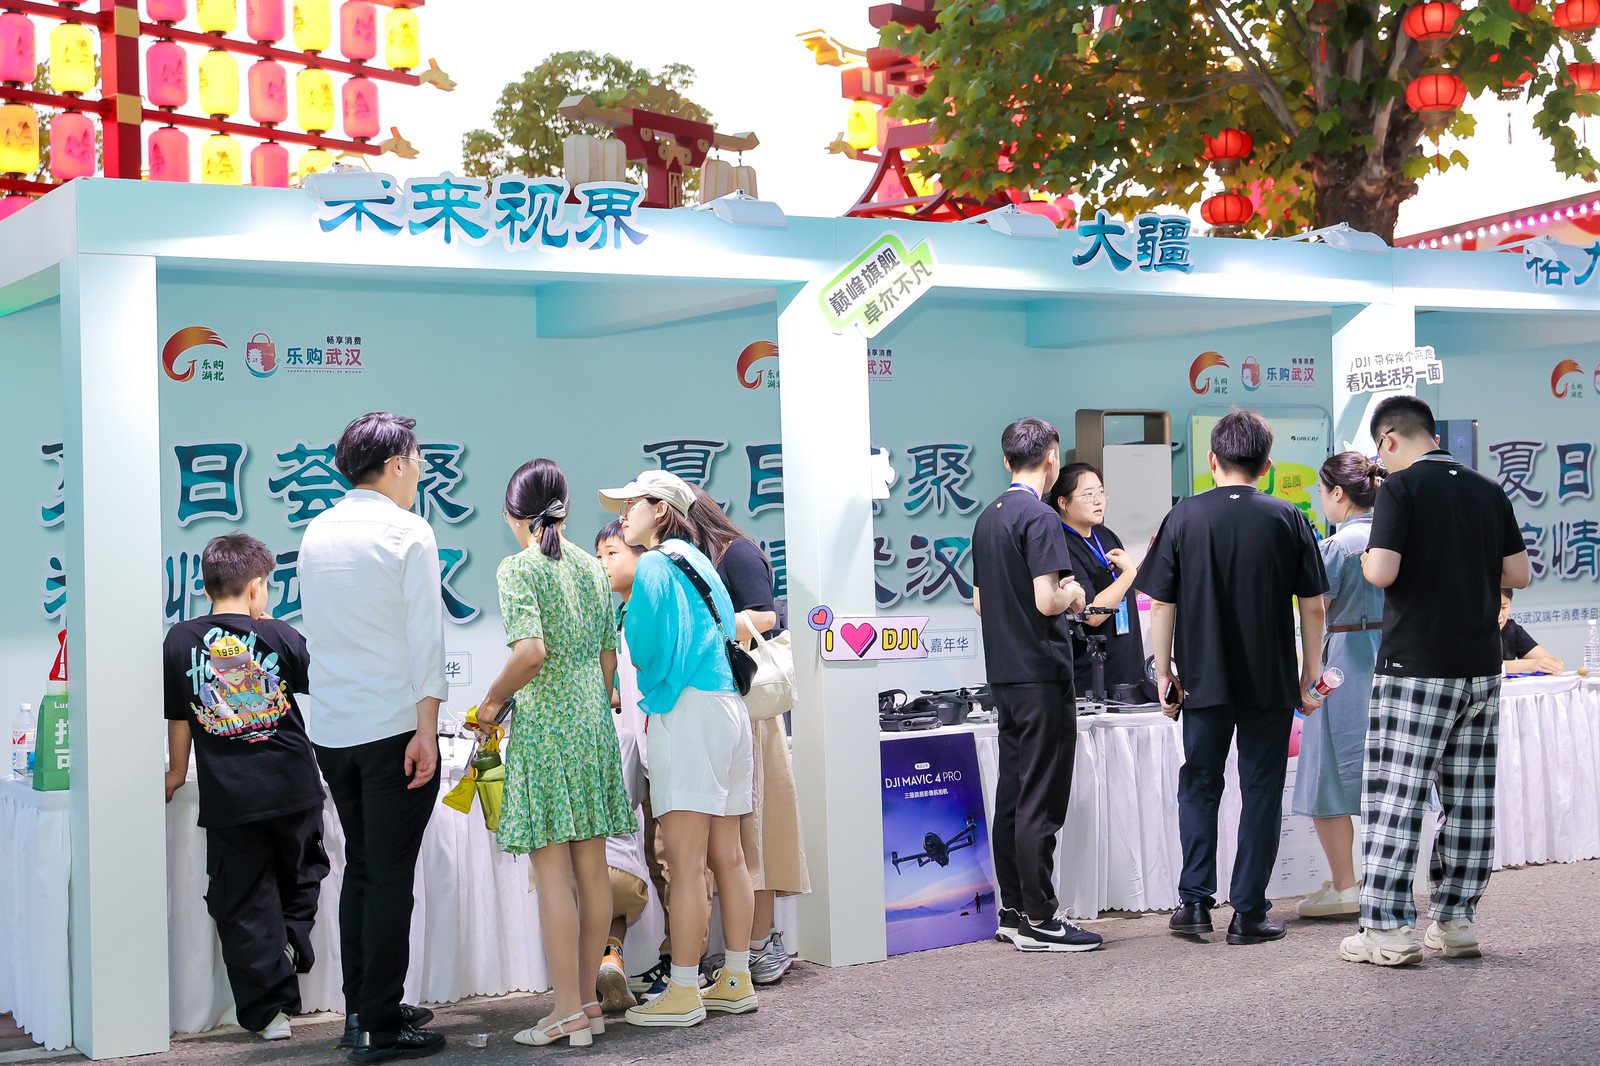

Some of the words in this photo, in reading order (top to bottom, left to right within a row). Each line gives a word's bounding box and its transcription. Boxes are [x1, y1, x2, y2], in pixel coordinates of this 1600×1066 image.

[318, 178, 650, 250] 未来视界
[1072, 212, 1195, 275] 大疆
[828, 247, 900, 317] 巅峰旗舰
[863, 260, 933, 325] 卓尔不凡
[326, 335, 362, 345] 畅享消费
[202, 358, 224, 370] 乐购
[286, 347, 363, 366] 乐购武汉
[1355, 356, 1371, 368] DJI
[202, 371, 225, 381] 湖北
[1266, 367, 1315, 382] 乐购武汉
[1346, 363, 1441, 392] 看见生活另一面
[643, 440, 977, 513] 夏日聚
[1489, 441, 1592, 501] 夏日
[1282, 475, 1302, 489] 品质
[1510, 607, 1600, 624] 25武汉端午消费季启
[825, 629, 834, 652] I
[881, 628, 918, 651] DJI
[217, 645, 241, 657] 1959
[217, 709, 281, 737] HIP-HOP
[885, 777, 901, 789] DJI
[902, 773, 933, 787] MAVIC
[935, 773, 942, 783] 4
[942, 770, 962, 782] PRO
